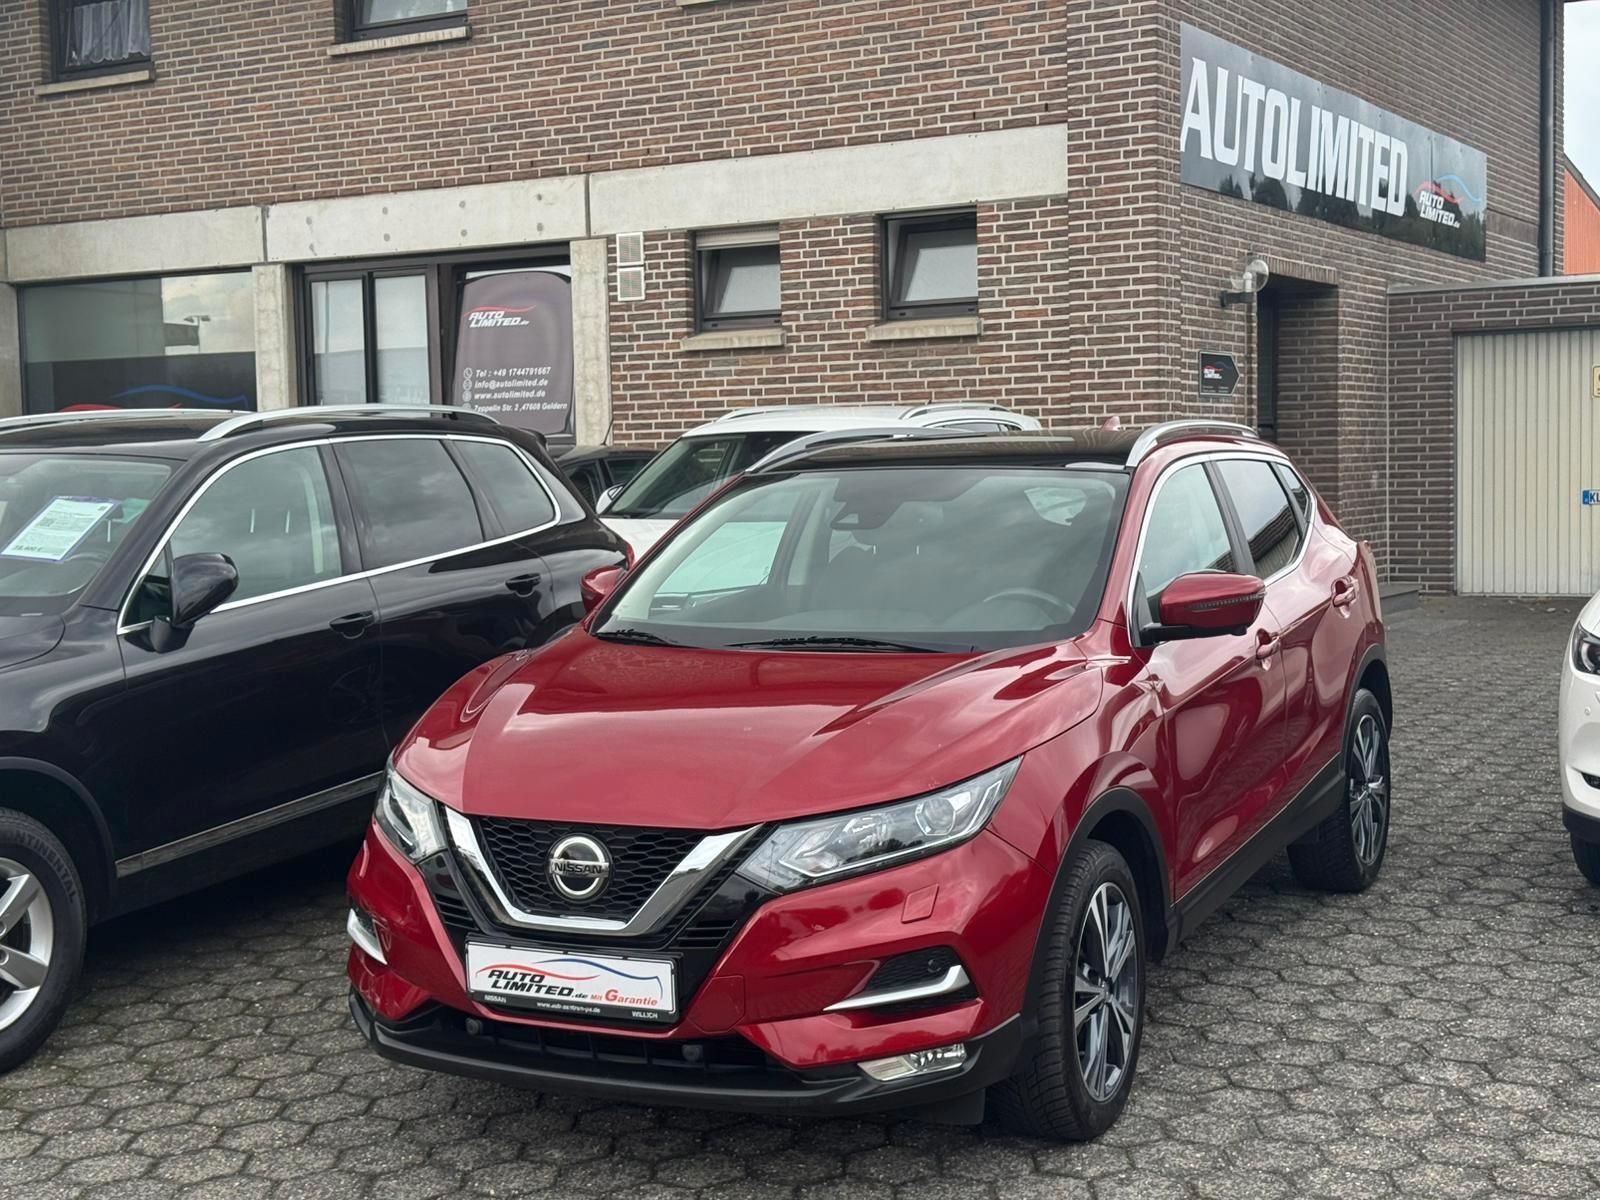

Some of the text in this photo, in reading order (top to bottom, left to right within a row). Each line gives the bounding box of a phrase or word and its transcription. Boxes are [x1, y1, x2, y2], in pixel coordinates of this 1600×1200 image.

[1180, 57, 1408, 217] AUTOLIMITED
[1419, 190, 1445, 210] AUTO
[468, 310, 505, 321] AUTO
[474, 390, 546, 400] www.autolimited.de
[554, 861, 602, 874] NISSAN
[488, 969, 545, 984] AUTO
[604, 988, 659, 1007] Garantie
